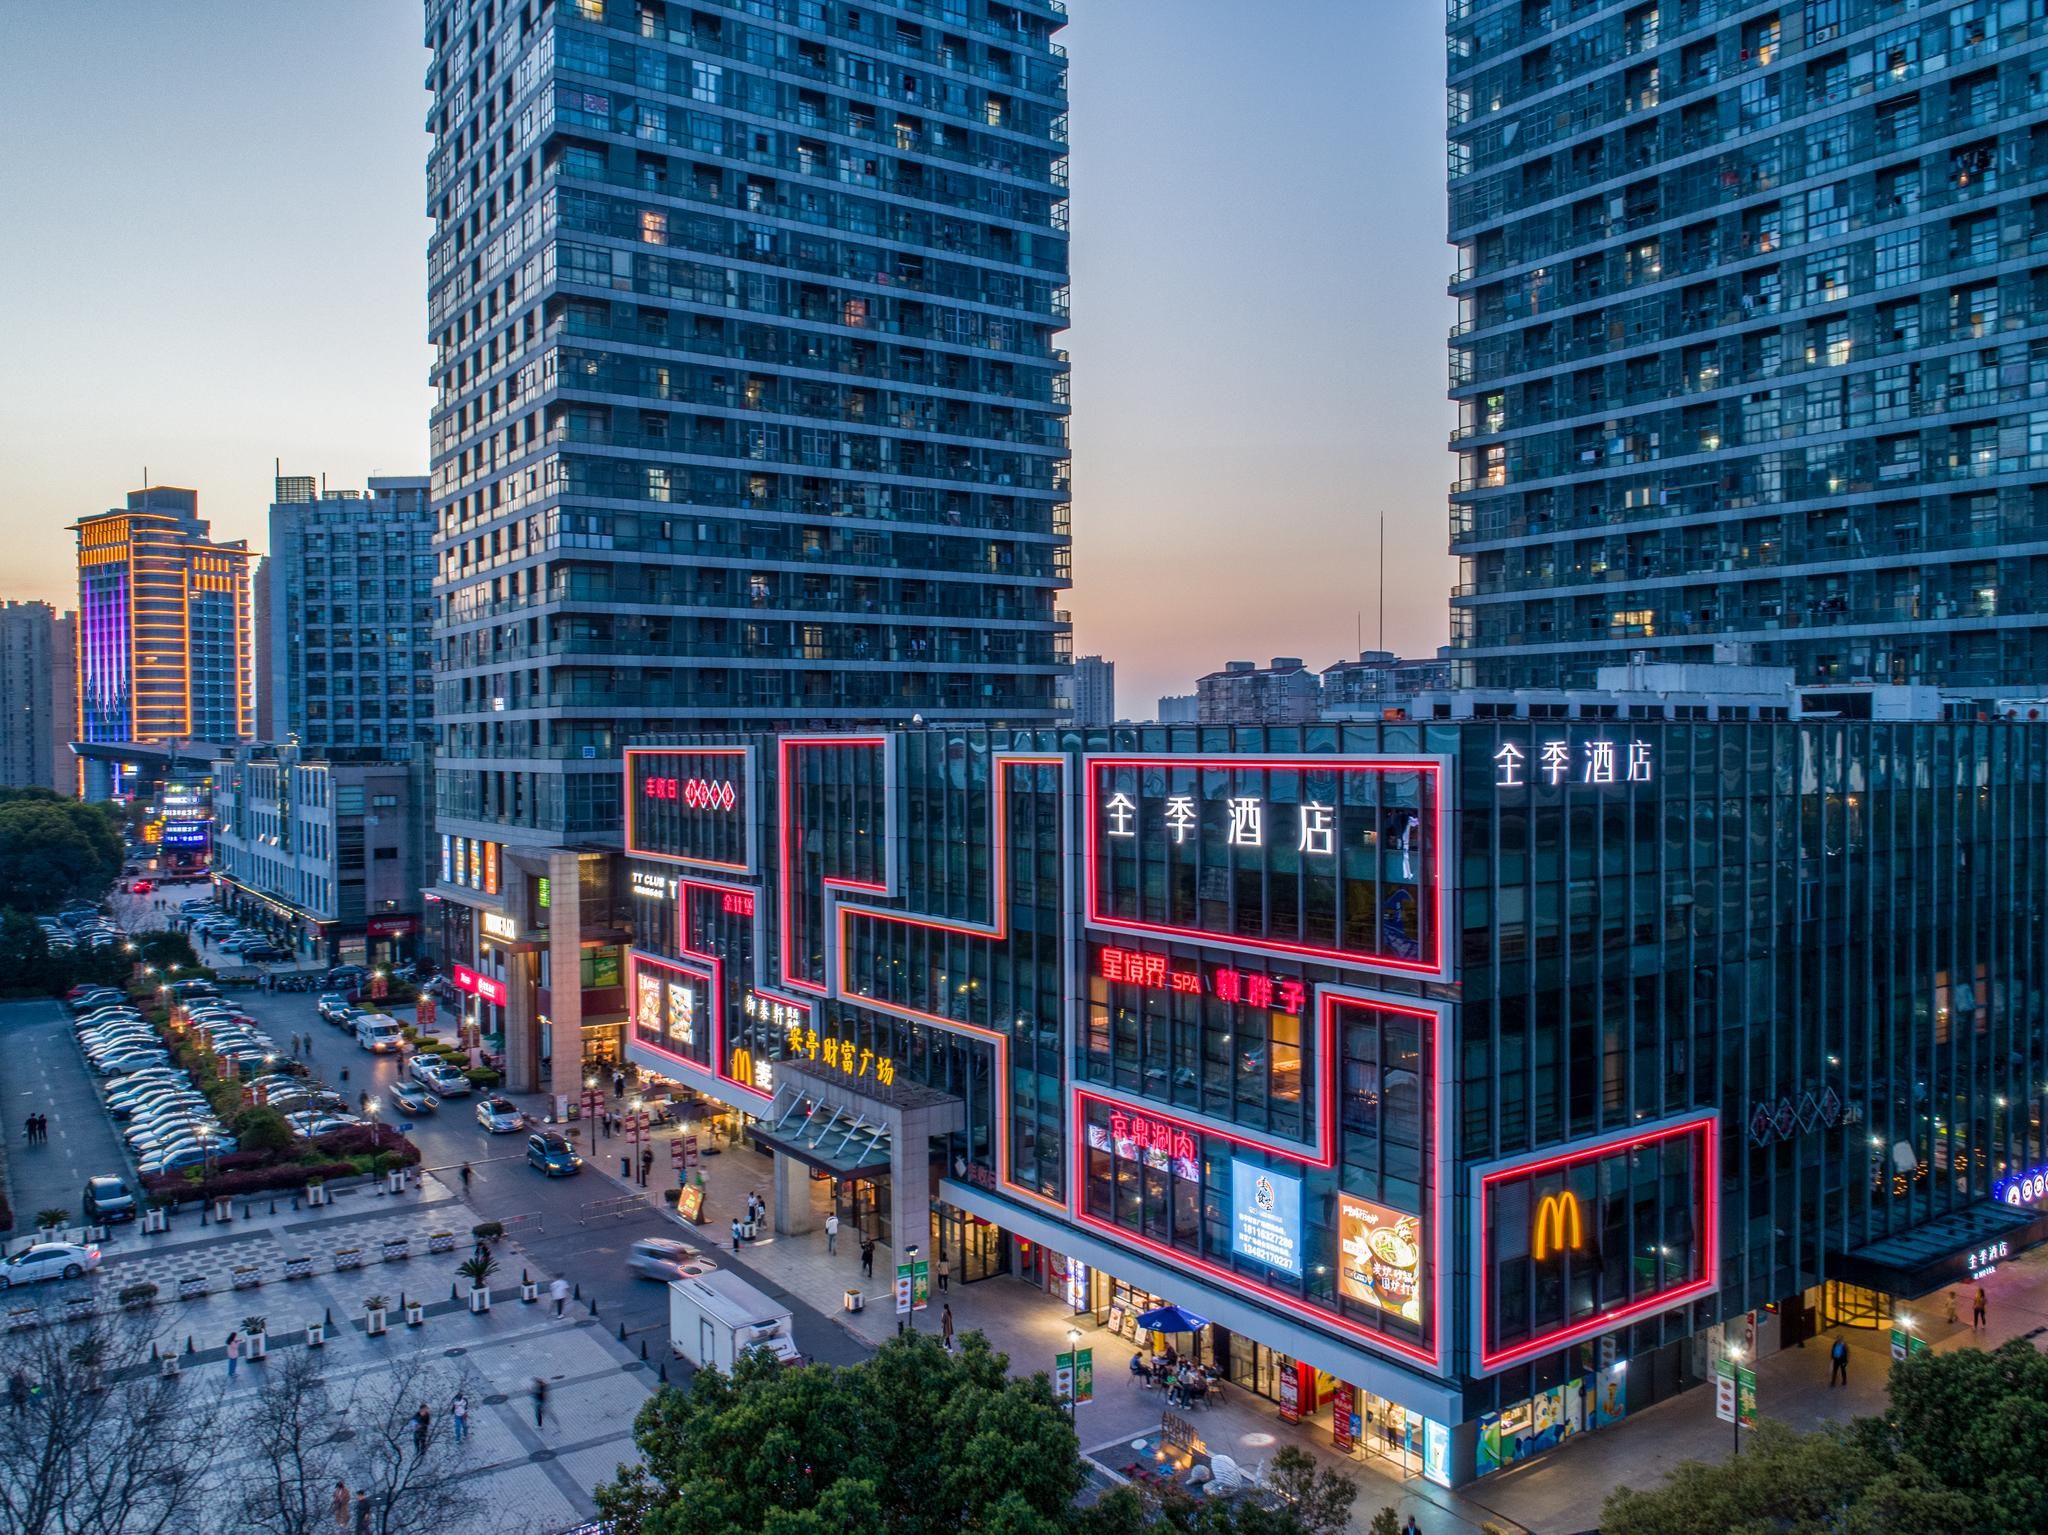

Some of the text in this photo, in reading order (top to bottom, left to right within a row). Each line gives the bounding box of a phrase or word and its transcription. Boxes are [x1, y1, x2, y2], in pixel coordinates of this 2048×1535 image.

[1493, 740, 1652, 786] 全季酒店
[1105, 792, 1336, 855] 全季酒店
[644, 874, 665, 888] CLUB
[1171, 973, 1201, 994] SPA
[788, 1026, 896, 1086] 安亭财富广场
[1110, 1111, 1196, 1162] 京鼎涮肉
